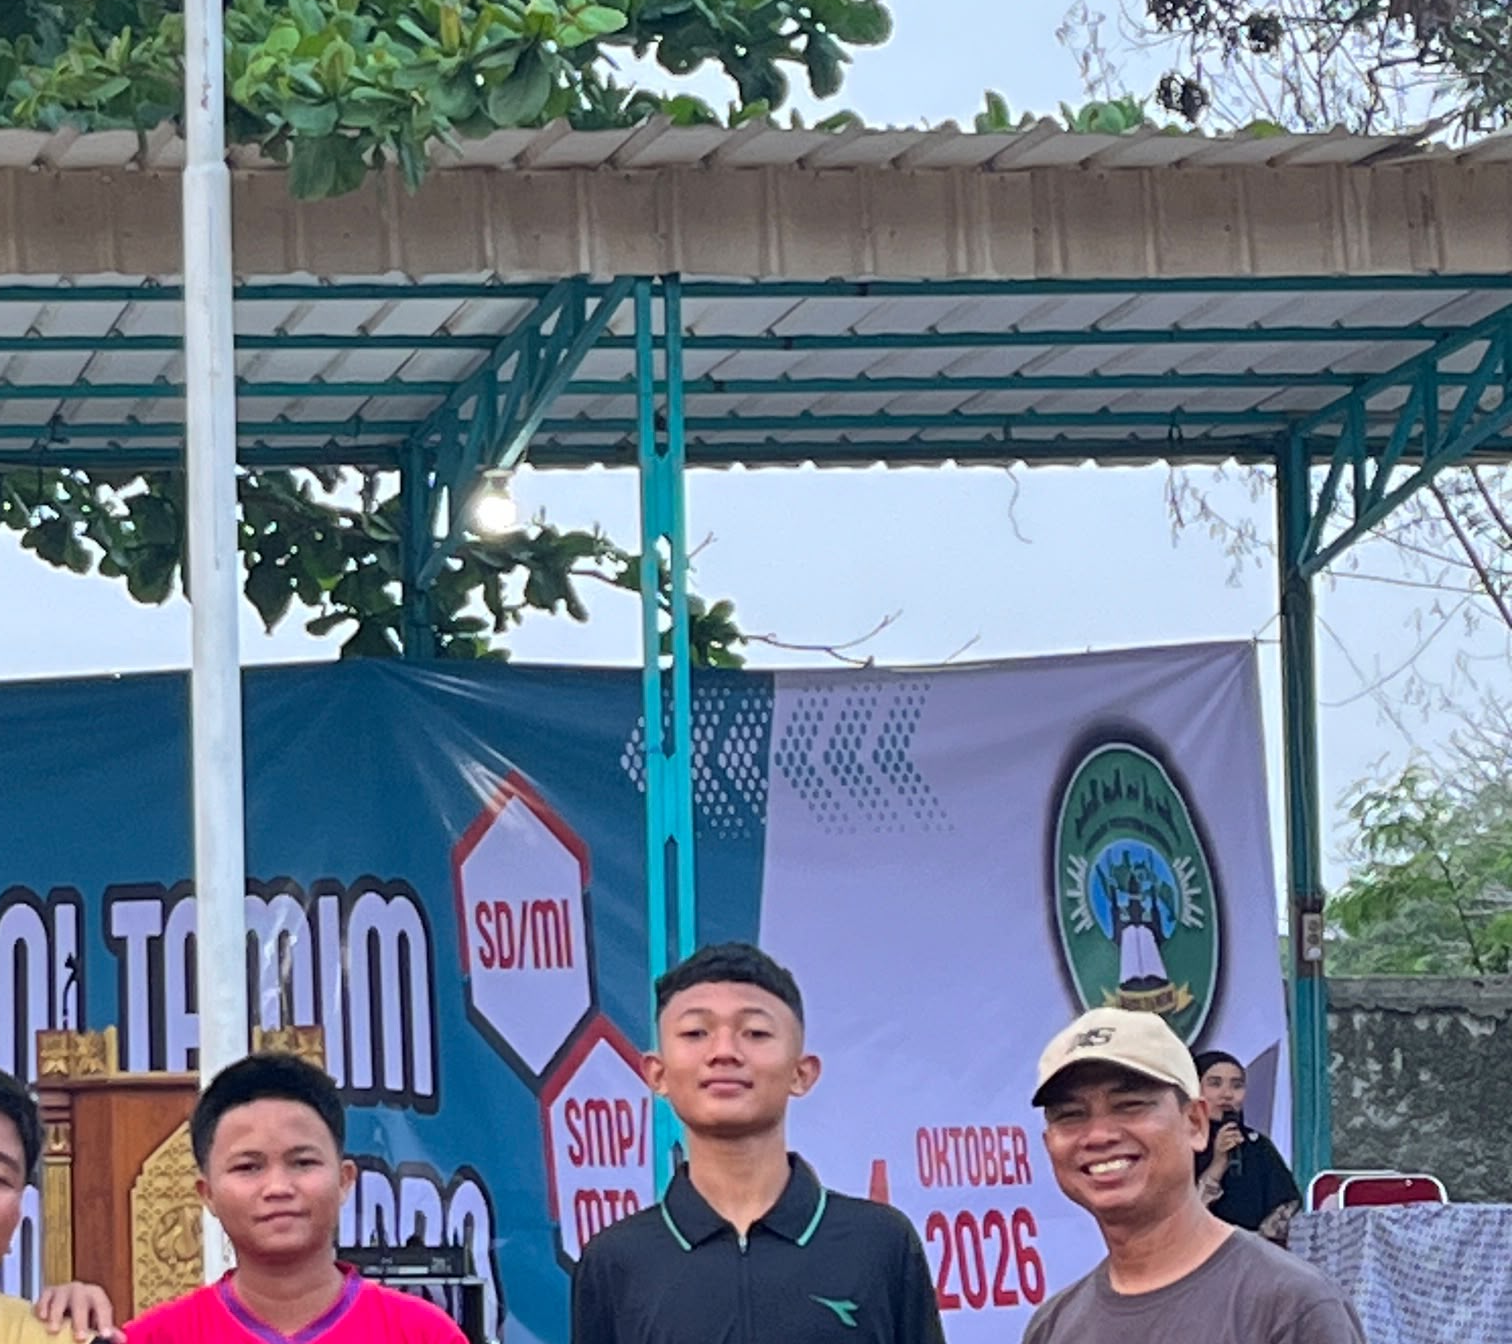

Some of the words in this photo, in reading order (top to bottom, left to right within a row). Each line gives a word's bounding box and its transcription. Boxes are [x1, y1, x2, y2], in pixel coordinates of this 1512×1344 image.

[475, 898, 573, 970] SD/MI
[564, 1097, 649, 1168] SMP/
[915, 1125, 1034, 1188] OKTOBER
[925, 1207, 1046, 1311] 2026
